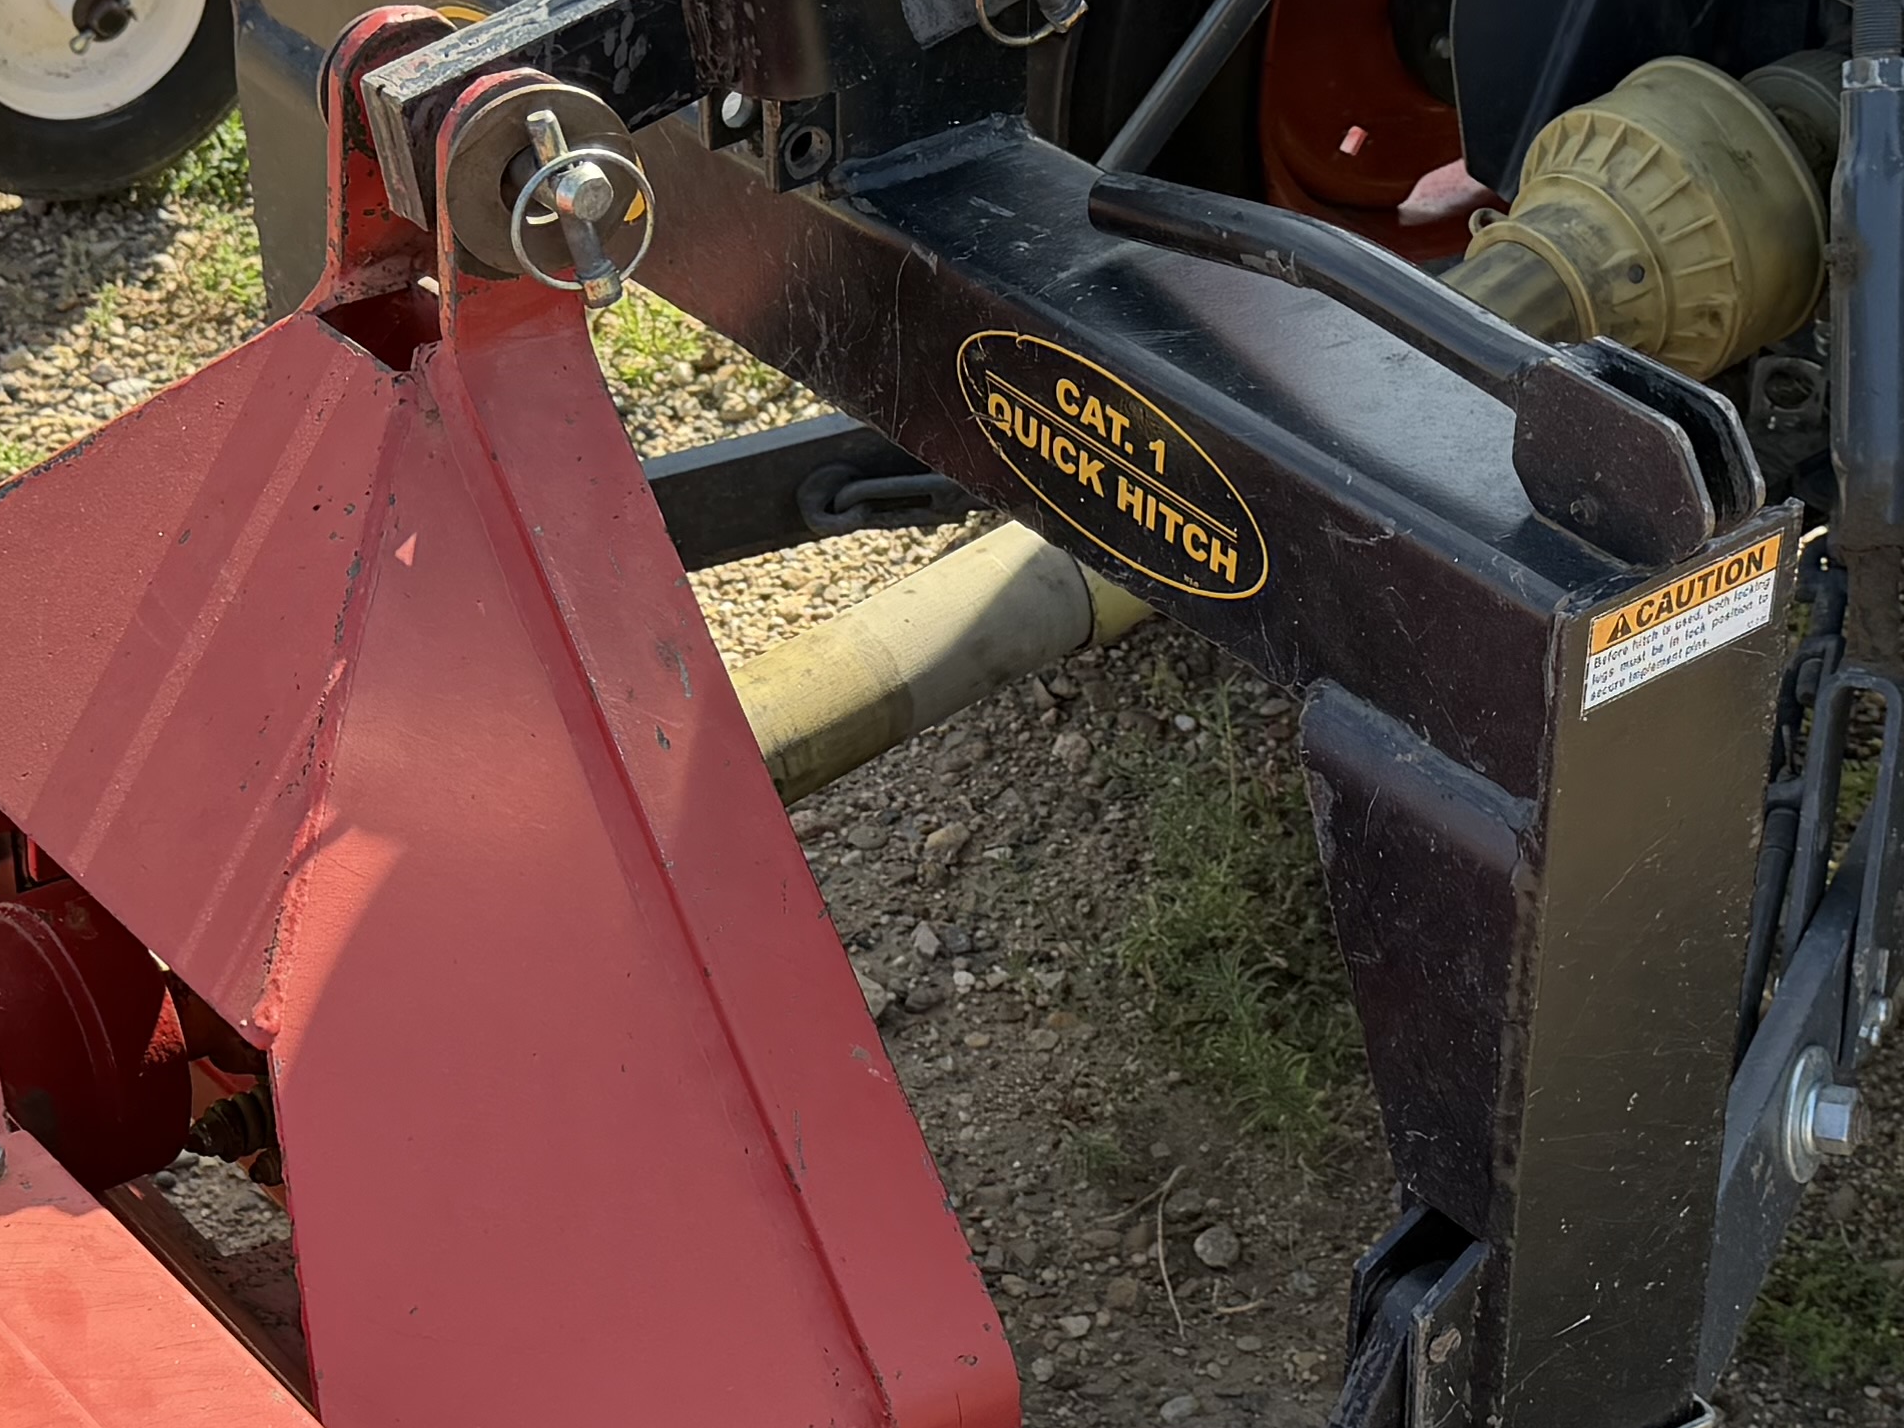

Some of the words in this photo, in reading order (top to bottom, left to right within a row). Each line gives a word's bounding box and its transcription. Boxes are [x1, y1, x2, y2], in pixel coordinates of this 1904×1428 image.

[1056, 378, 1133, 455] CAT.
[1149, 439, 1168, 474] 1
[987, 392, 1105, 498] QUICK
[1117, 475, 1238, 583] HITCH
[1636, 546, 1766, 628] CAUTION
[1591, 666, 1615, 685] lugs
[1619, 649, 1646, 672] must
[1650, 642, 1664, 657] be
[1668, 635, 1680, 649] in
[1684, 621, 1706, 641] lock
[1593, 645, 1629, 669] Before
[1631, 629, 1659, 651] hitch
[1589, 677, 1626, 702] secure
